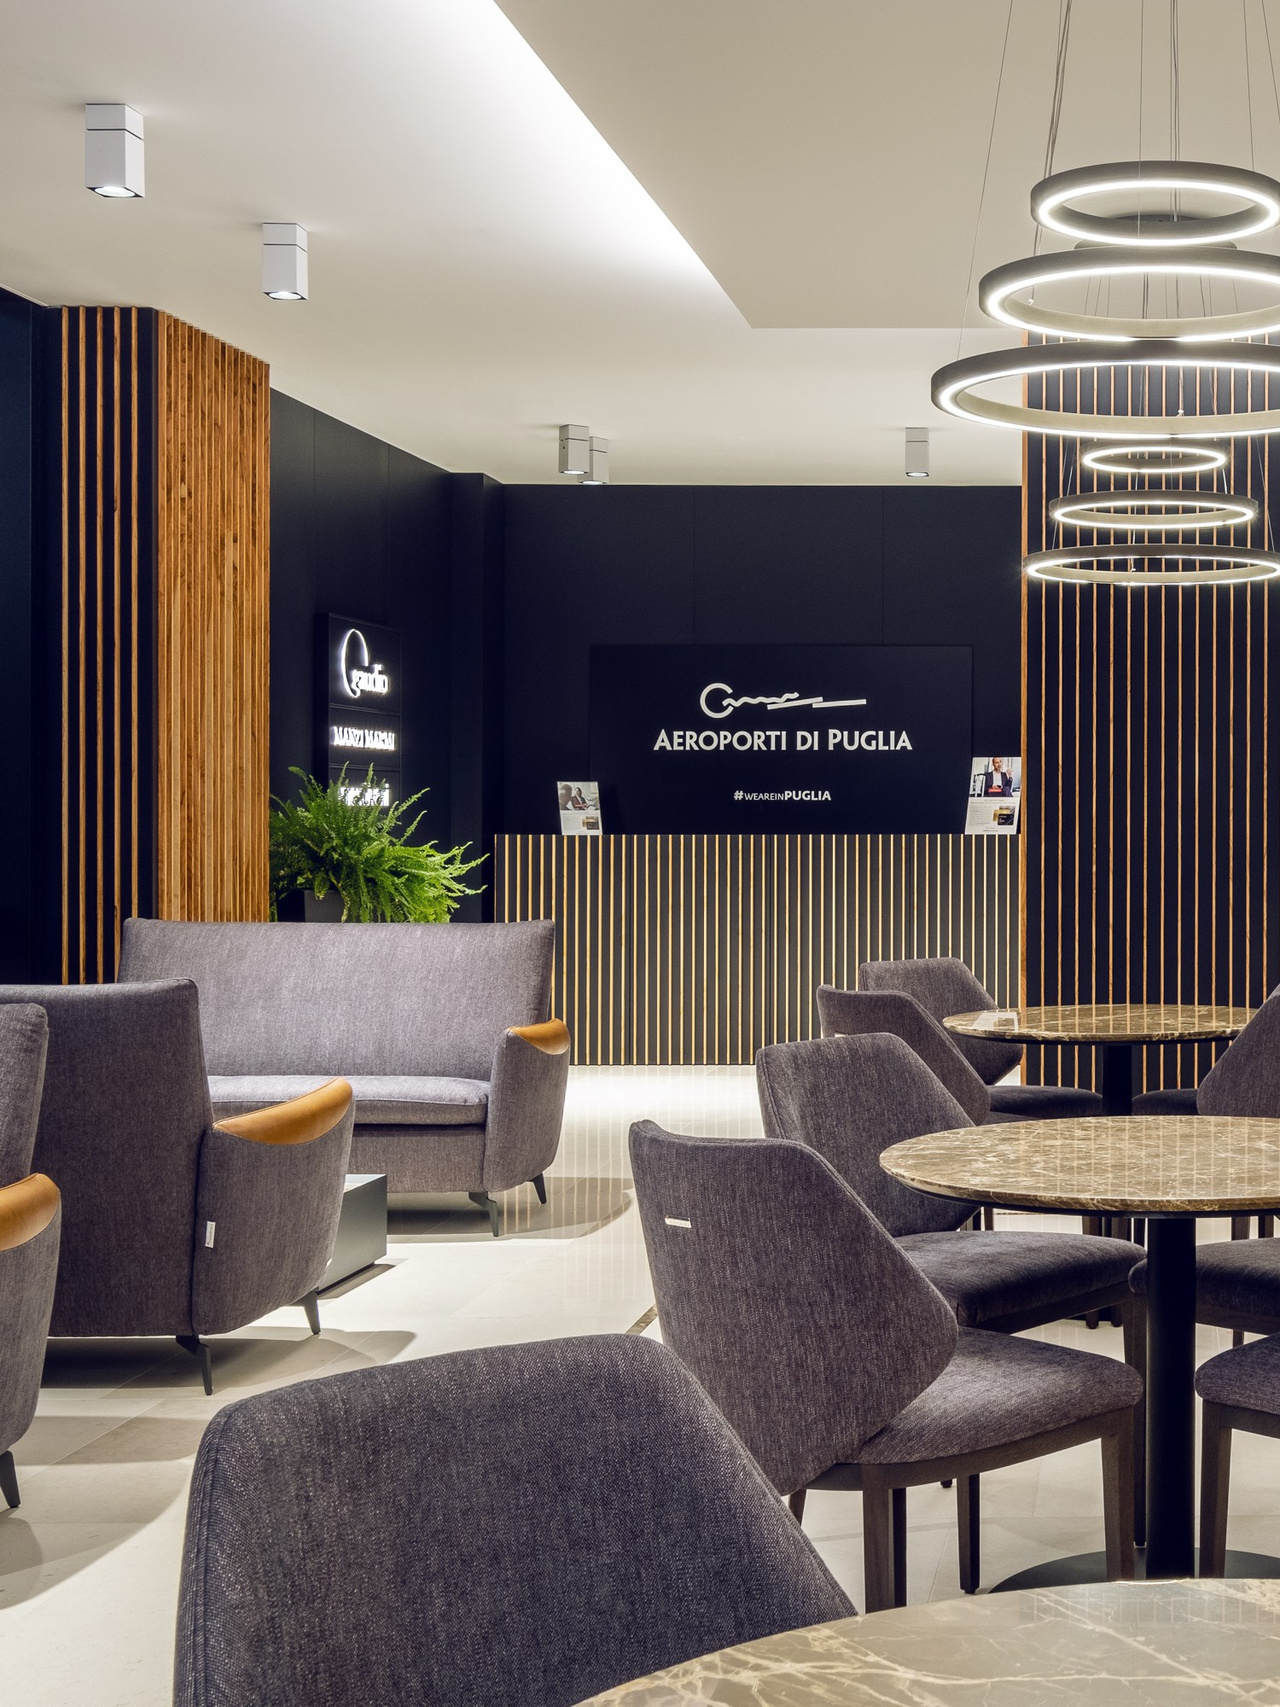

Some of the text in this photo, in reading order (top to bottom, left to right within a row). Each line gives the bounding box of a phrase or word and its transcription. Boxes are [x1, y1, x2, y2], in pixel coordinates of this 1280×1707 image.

[653, 729, 913, 751] AEROPORTI DI PUGLIA
